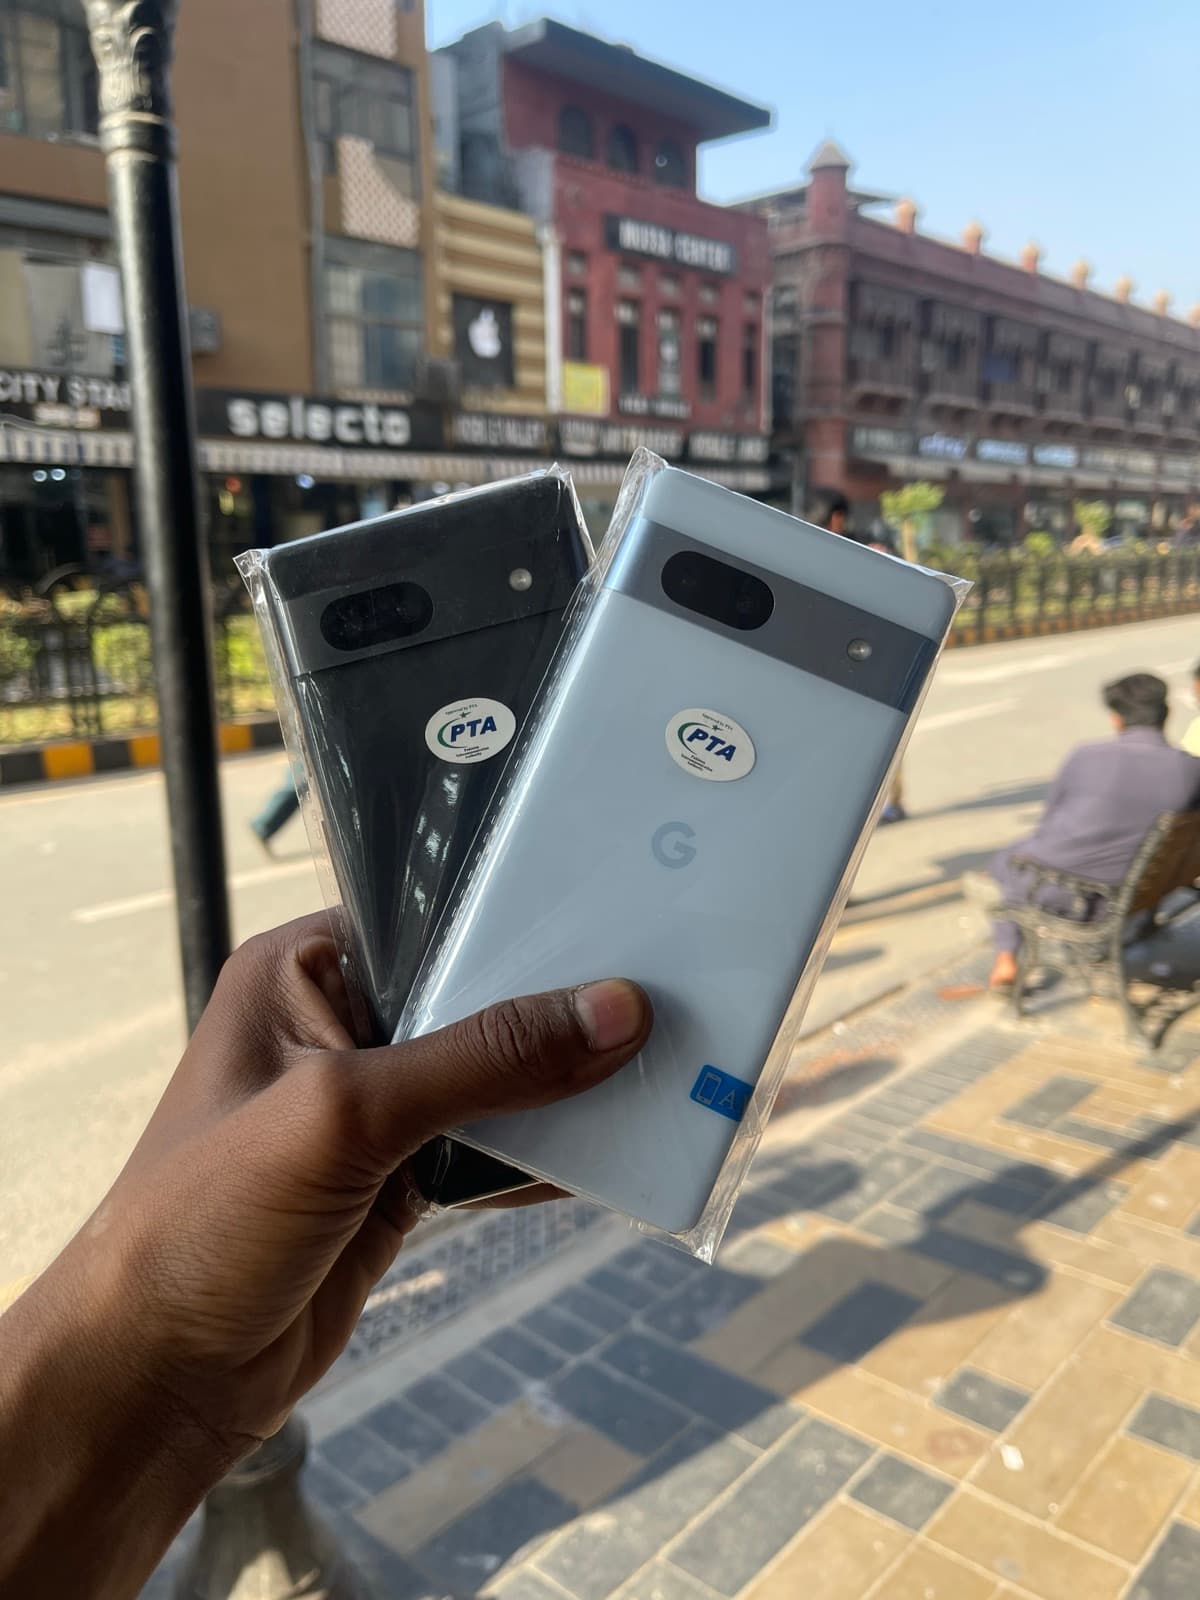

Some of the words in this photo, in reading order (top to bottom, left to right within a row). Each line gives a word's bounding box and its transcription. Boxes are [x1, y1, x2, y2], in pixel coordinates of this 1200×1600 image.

[450, 715, 497, 743] PTA
[686, 727, 737, 762] PTA
[651, 821, 697, 869] G
